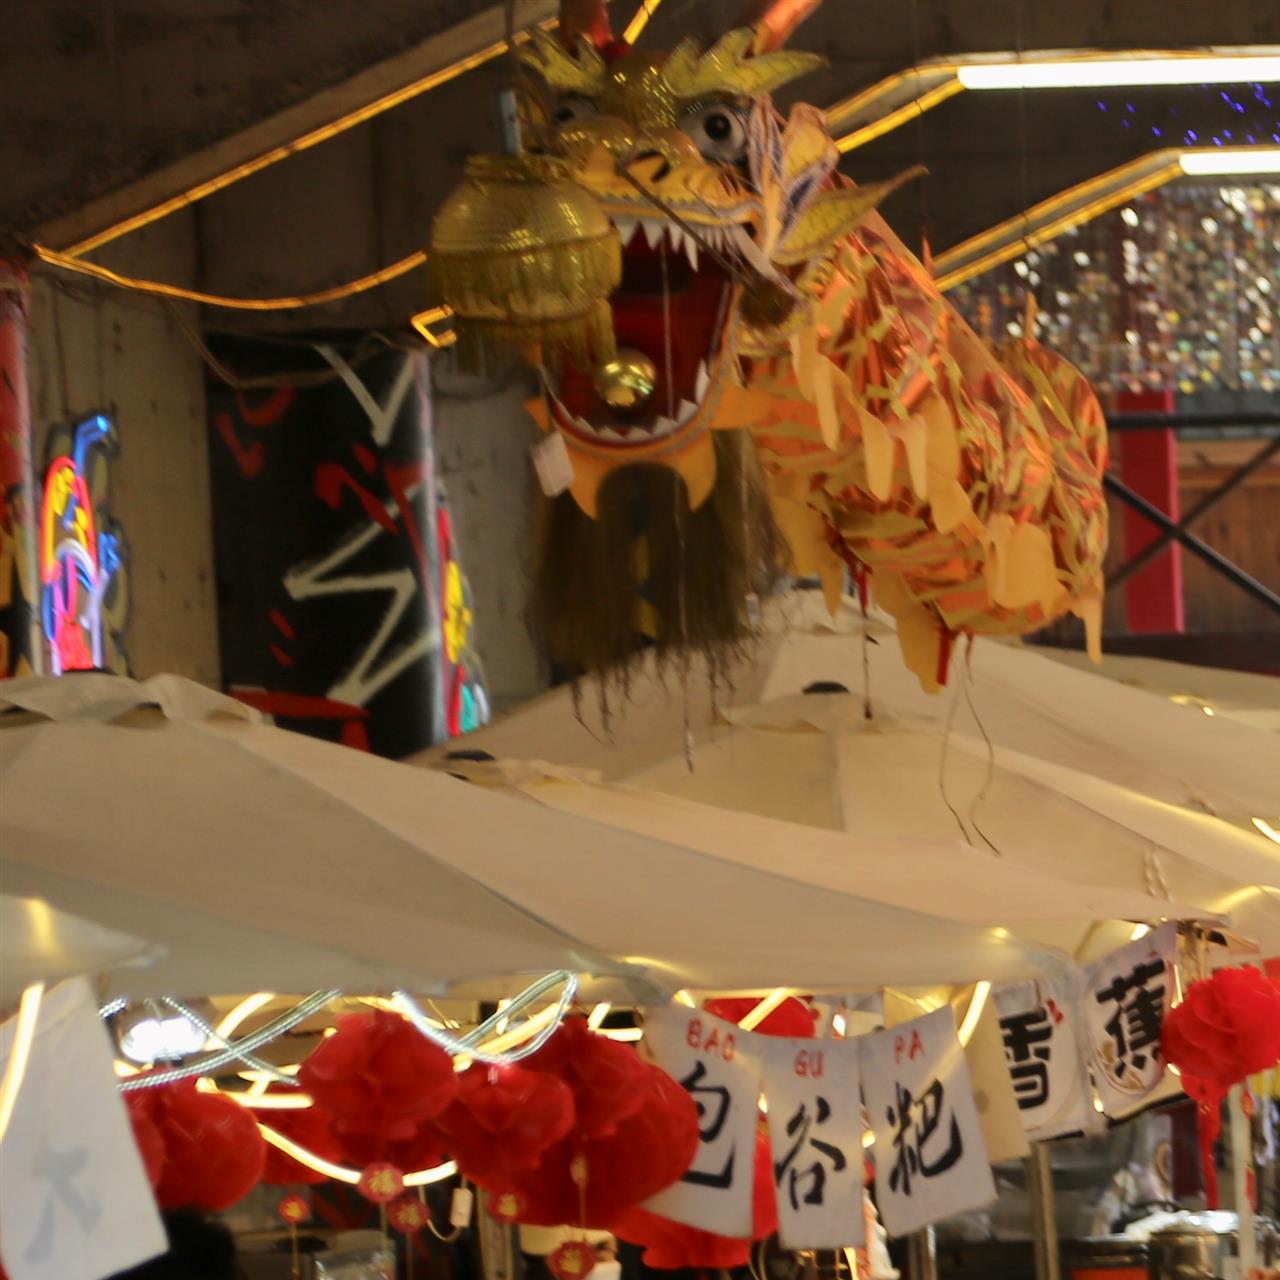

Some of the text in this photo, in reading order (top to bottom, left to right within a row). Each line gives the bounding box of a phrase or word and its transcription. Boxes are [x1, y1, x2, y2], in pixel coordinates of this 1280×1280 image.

[686, 1018, 736, 1063] BAO
[893, 1028, 926, 1064] PA
[794, 1049, 825, 1079] GU
